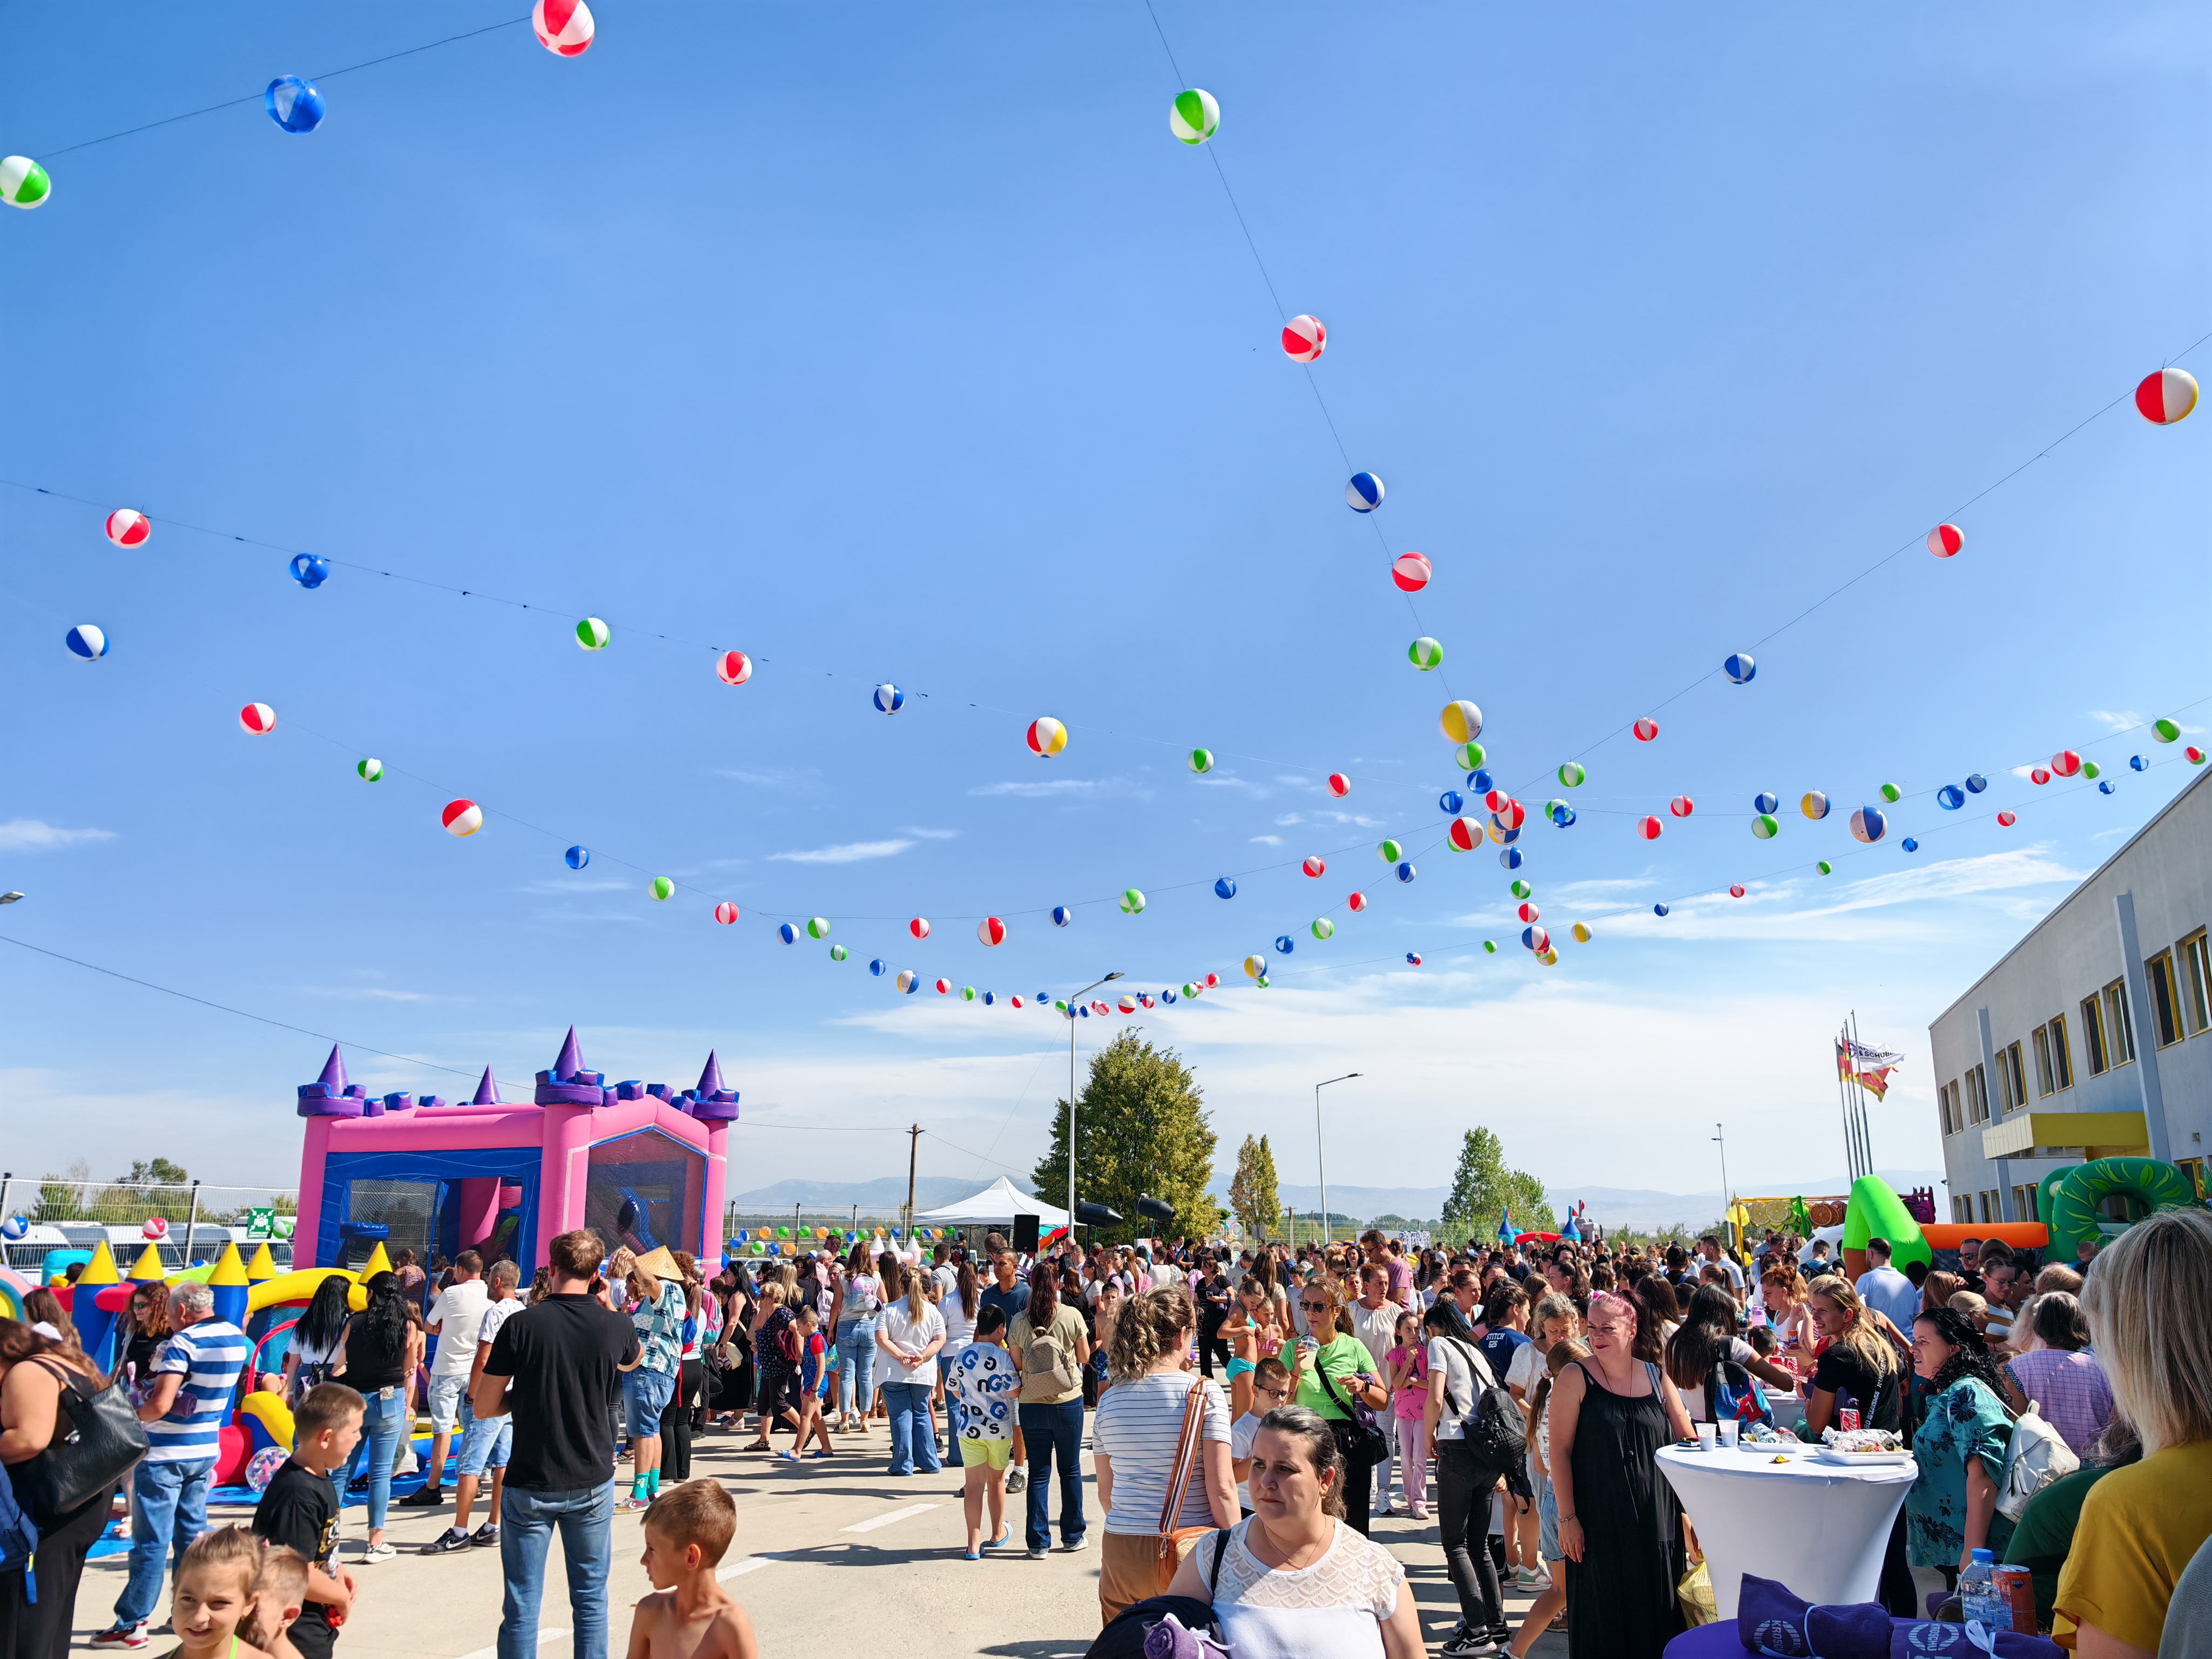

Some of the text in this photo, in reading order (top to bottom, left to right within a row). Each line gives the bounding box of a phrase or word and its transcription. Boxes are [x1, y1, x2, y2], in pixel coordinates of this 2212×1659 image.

[1486, 1332, 1506, 1340] STITCH
[1488, 1340, 1498, 1348] 626
[1745, 1401, 1754, 1413] 7
